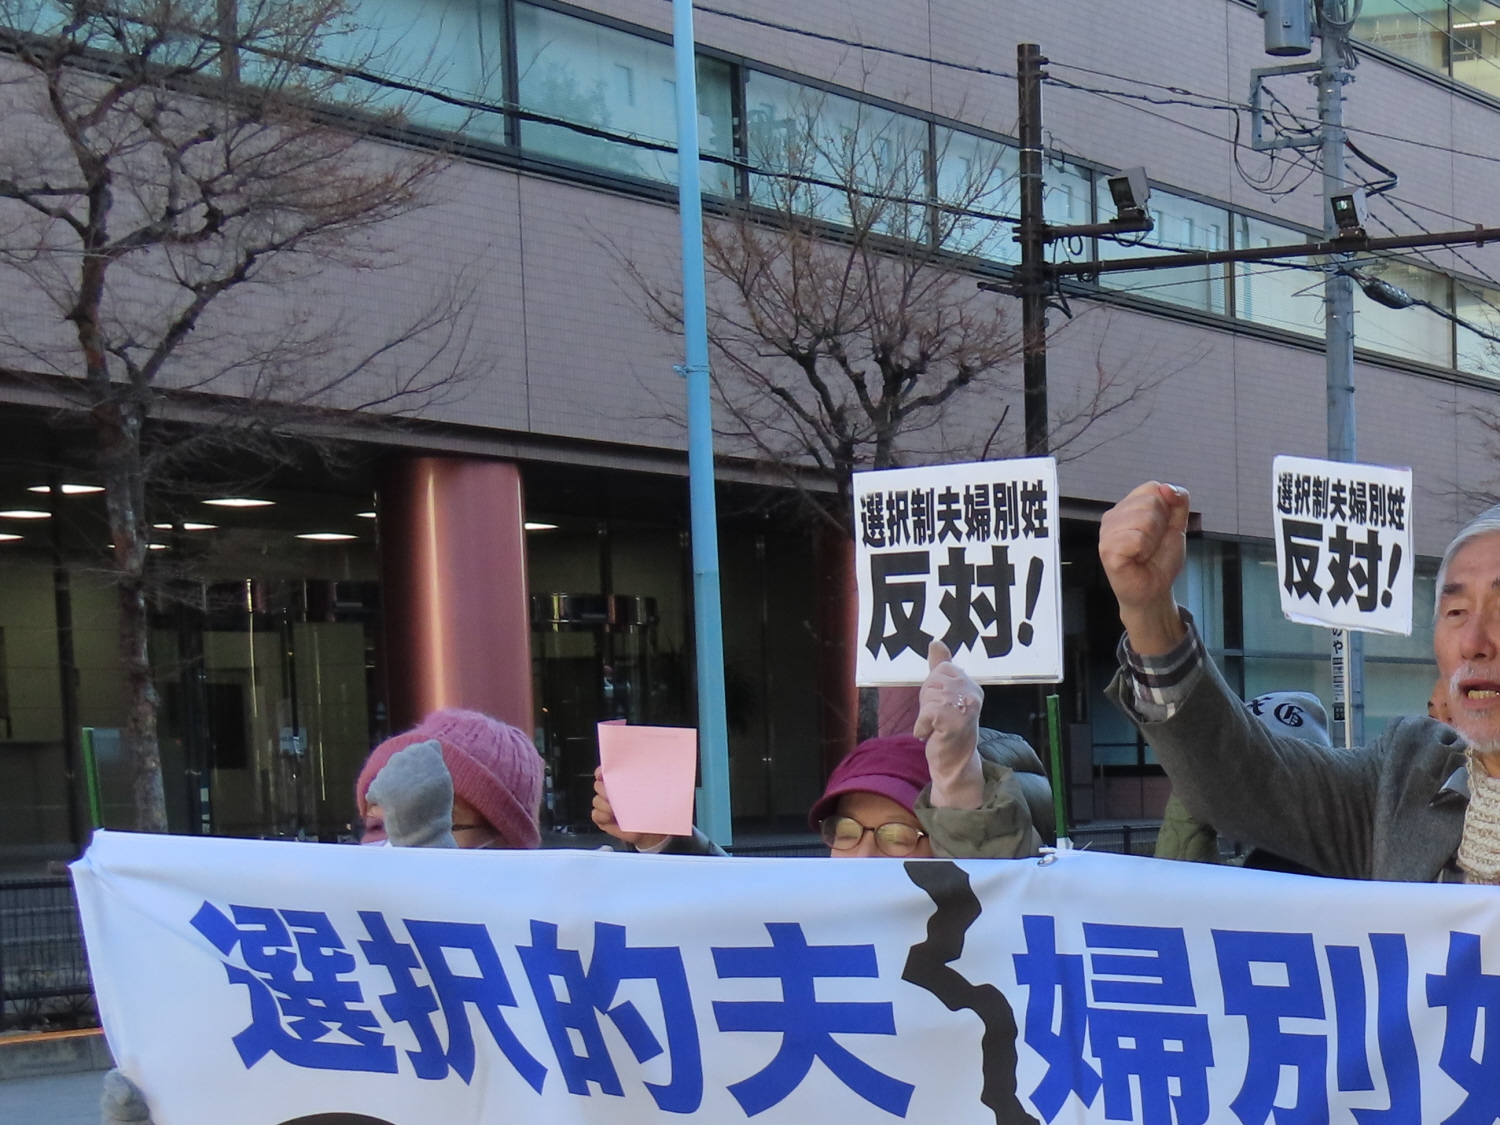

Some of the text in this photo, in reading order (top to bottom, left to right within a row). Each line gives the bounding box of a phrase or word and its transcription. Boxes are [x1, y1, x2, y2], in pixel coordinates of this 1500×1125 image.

[861, 479, 1048, 547] 選択制夫婦別姓
[1277, 471, 1405, 531] 選択制夫婦別姓
[865, 546, 1045, 661] 反対!
[1282, 519, 1403, 612] 反対!
